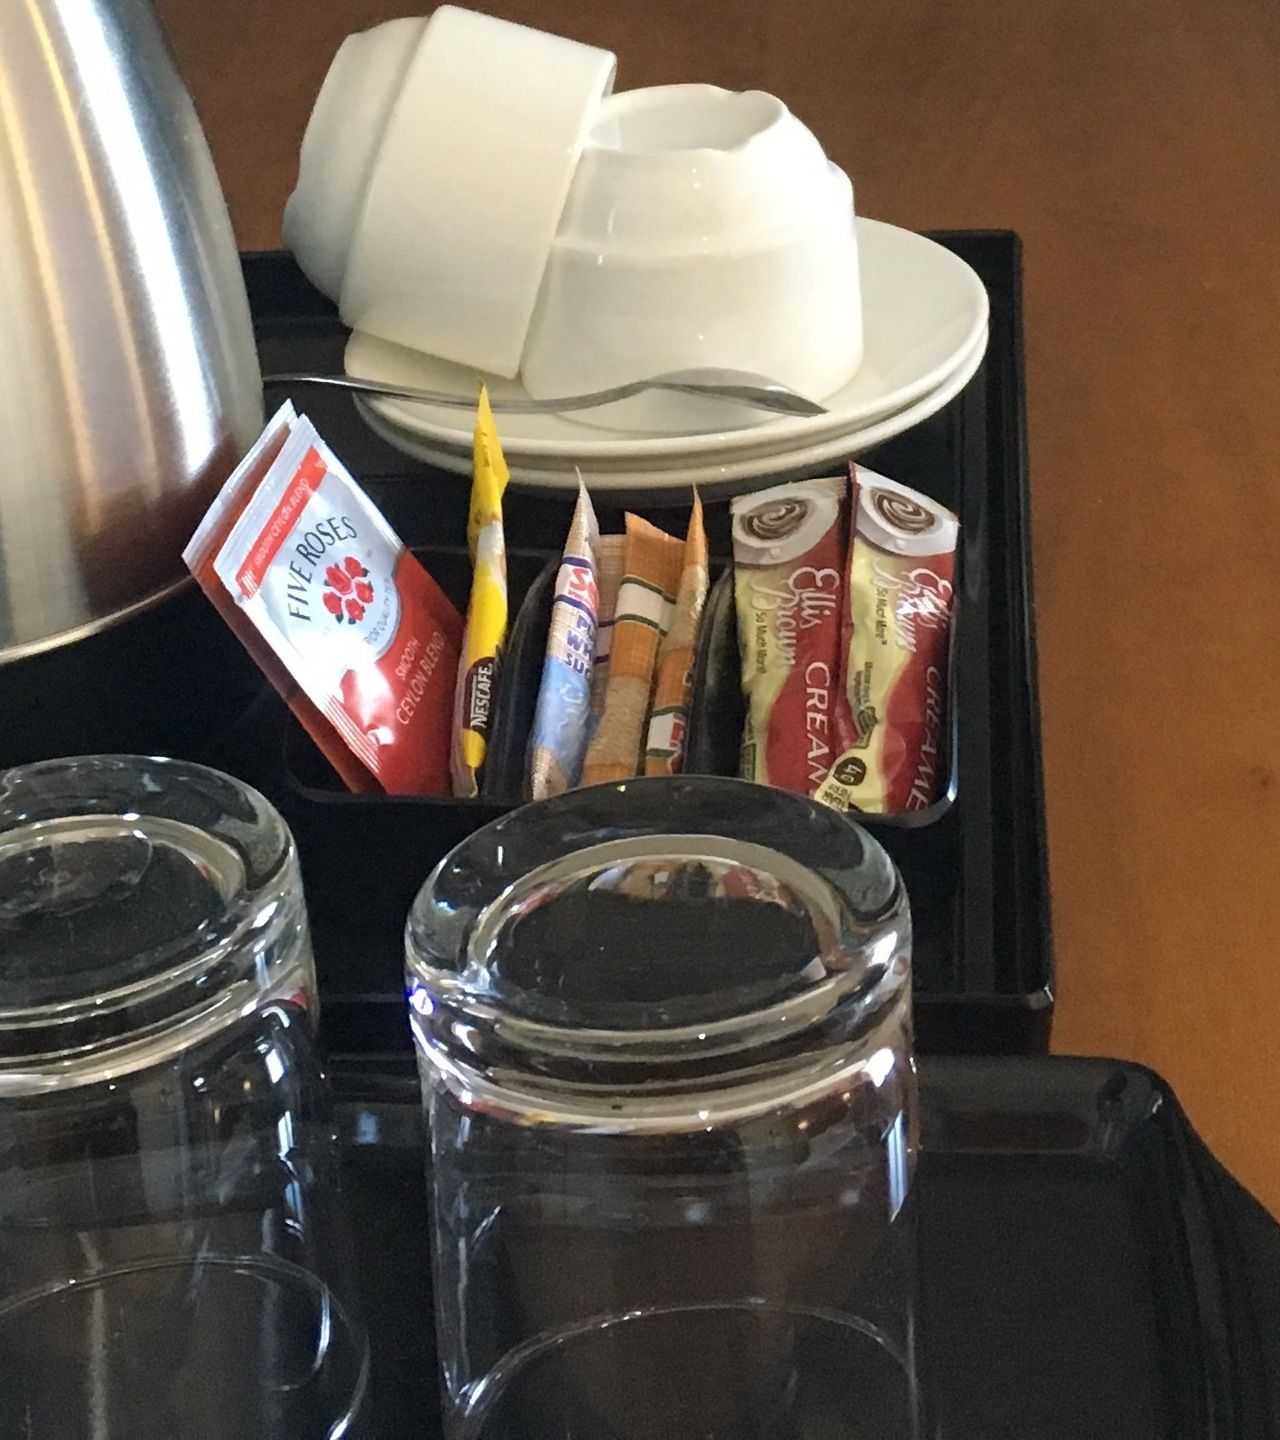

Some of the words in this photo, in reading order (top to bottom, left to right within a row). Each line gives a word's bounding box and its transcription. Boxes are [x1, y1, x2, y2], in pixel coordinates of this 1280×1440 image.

[295, 515, 359, 568] ROSES
[287, 560, 314, 622] FIVE
[395, 669, 429, 725] CEYLON
[419, 630, 447, 676] BLEND
[905, 666, 942, 811] CREAME
